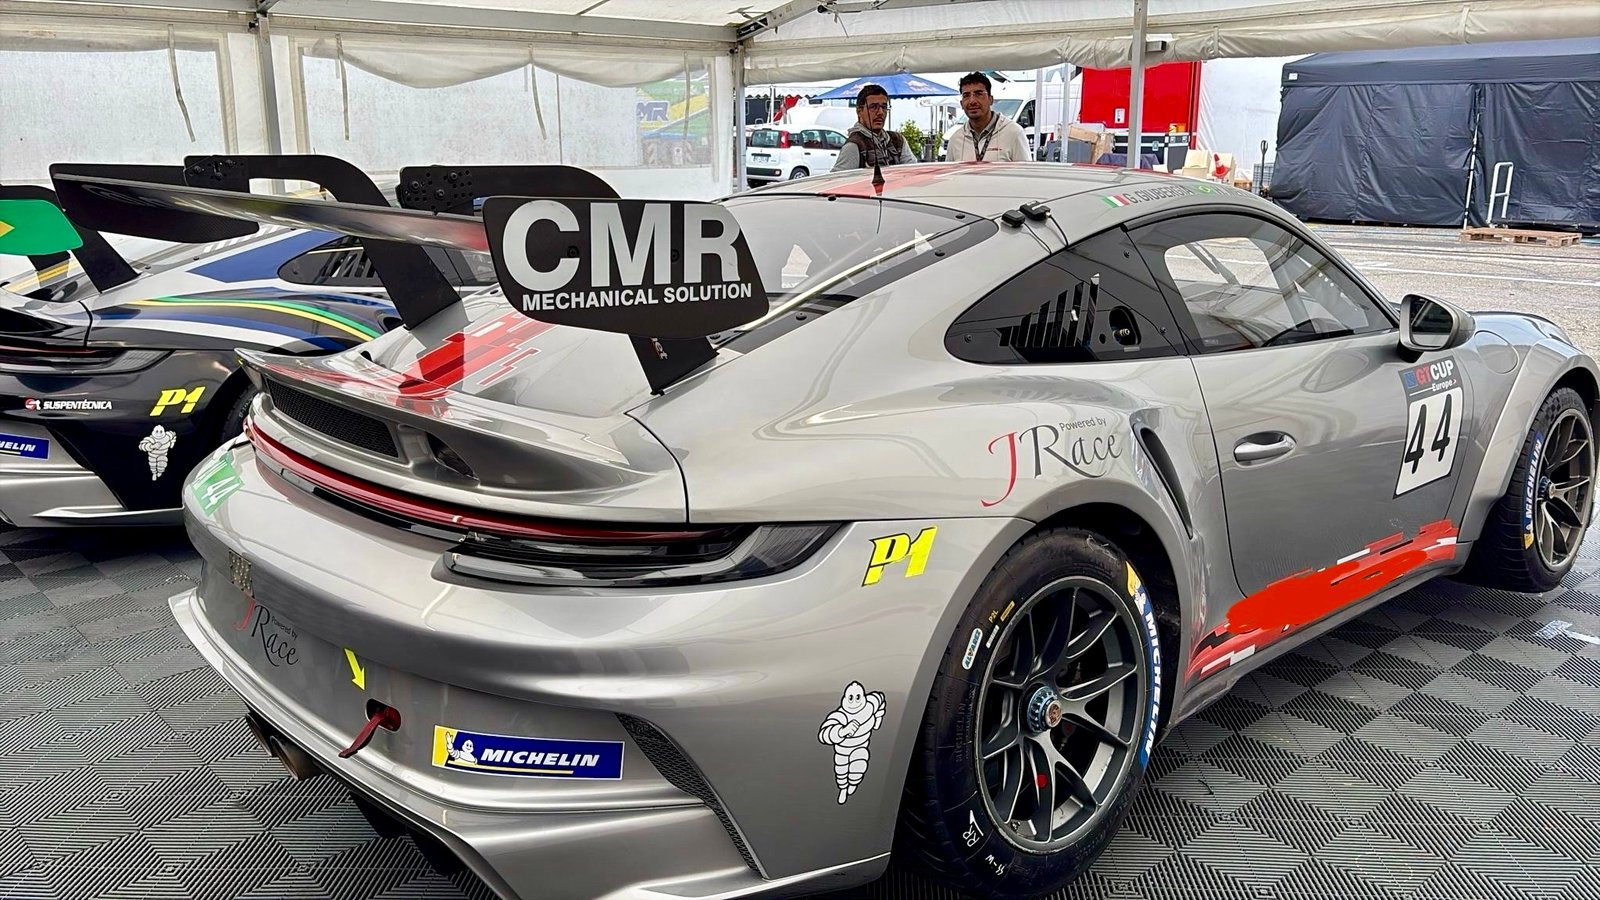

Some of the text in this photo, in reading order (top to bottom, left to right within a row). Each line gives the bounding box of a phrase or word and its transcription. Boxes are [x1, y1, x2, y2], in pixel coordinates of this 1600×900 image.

[636, 102, 669, 121] MR
[502, 200, 741, 291] CMR
[522, 283, 752, 311] MECHANICAL SOLUTION
[1432, 381, 1453, 392] Europe
[43, 399, 113, 410] SUSPENTÉCNICA
[150, 386, 206, 417] P1
[1059, 417, 1107, 432] Powered by
[1404, 393, 1453, 475] 44
[0, 440, 36, 452] HELIN
[1525, 439, 1542, 519] MICHELIN
[861, 526, 937, 587] P1
[1144, 611, 1162, 758] MICHELIN
[481, 748, 600, 767] MICHELIN
[963, 825, 980, 847] RR
